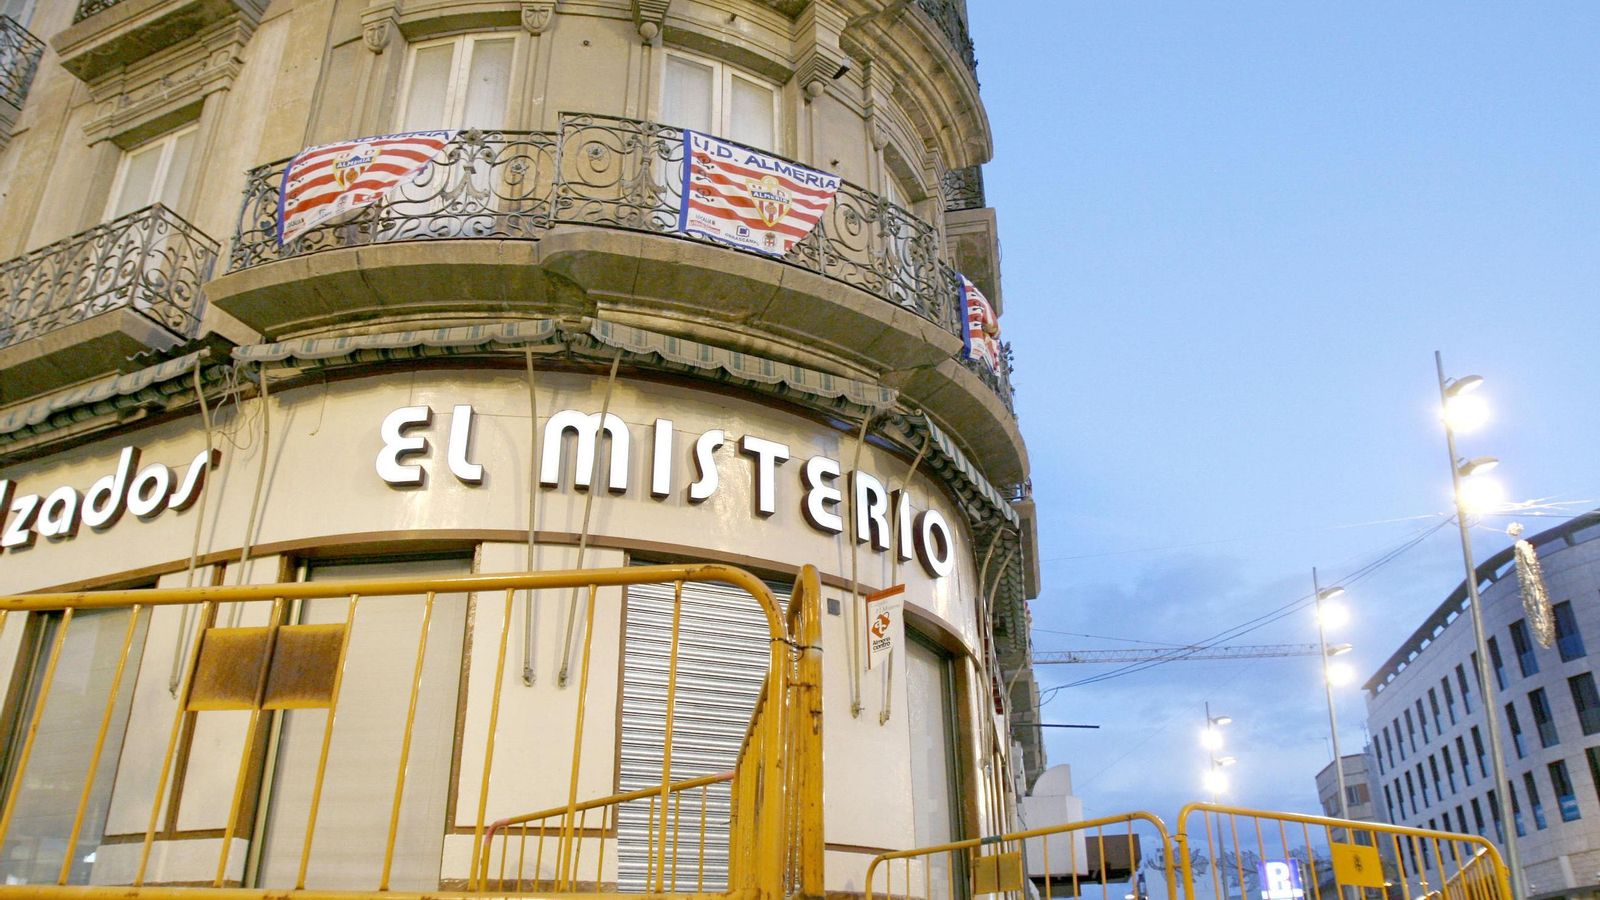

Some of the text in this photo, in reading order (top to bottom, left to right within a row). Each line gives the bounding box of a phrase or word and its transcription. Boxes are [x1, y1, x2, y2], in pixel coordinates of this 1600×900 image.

[744, 154, 837, 189] ALMERIA
[0, 446, 221, 549] zados
[540, 409, 954, 578] MISTERIO
